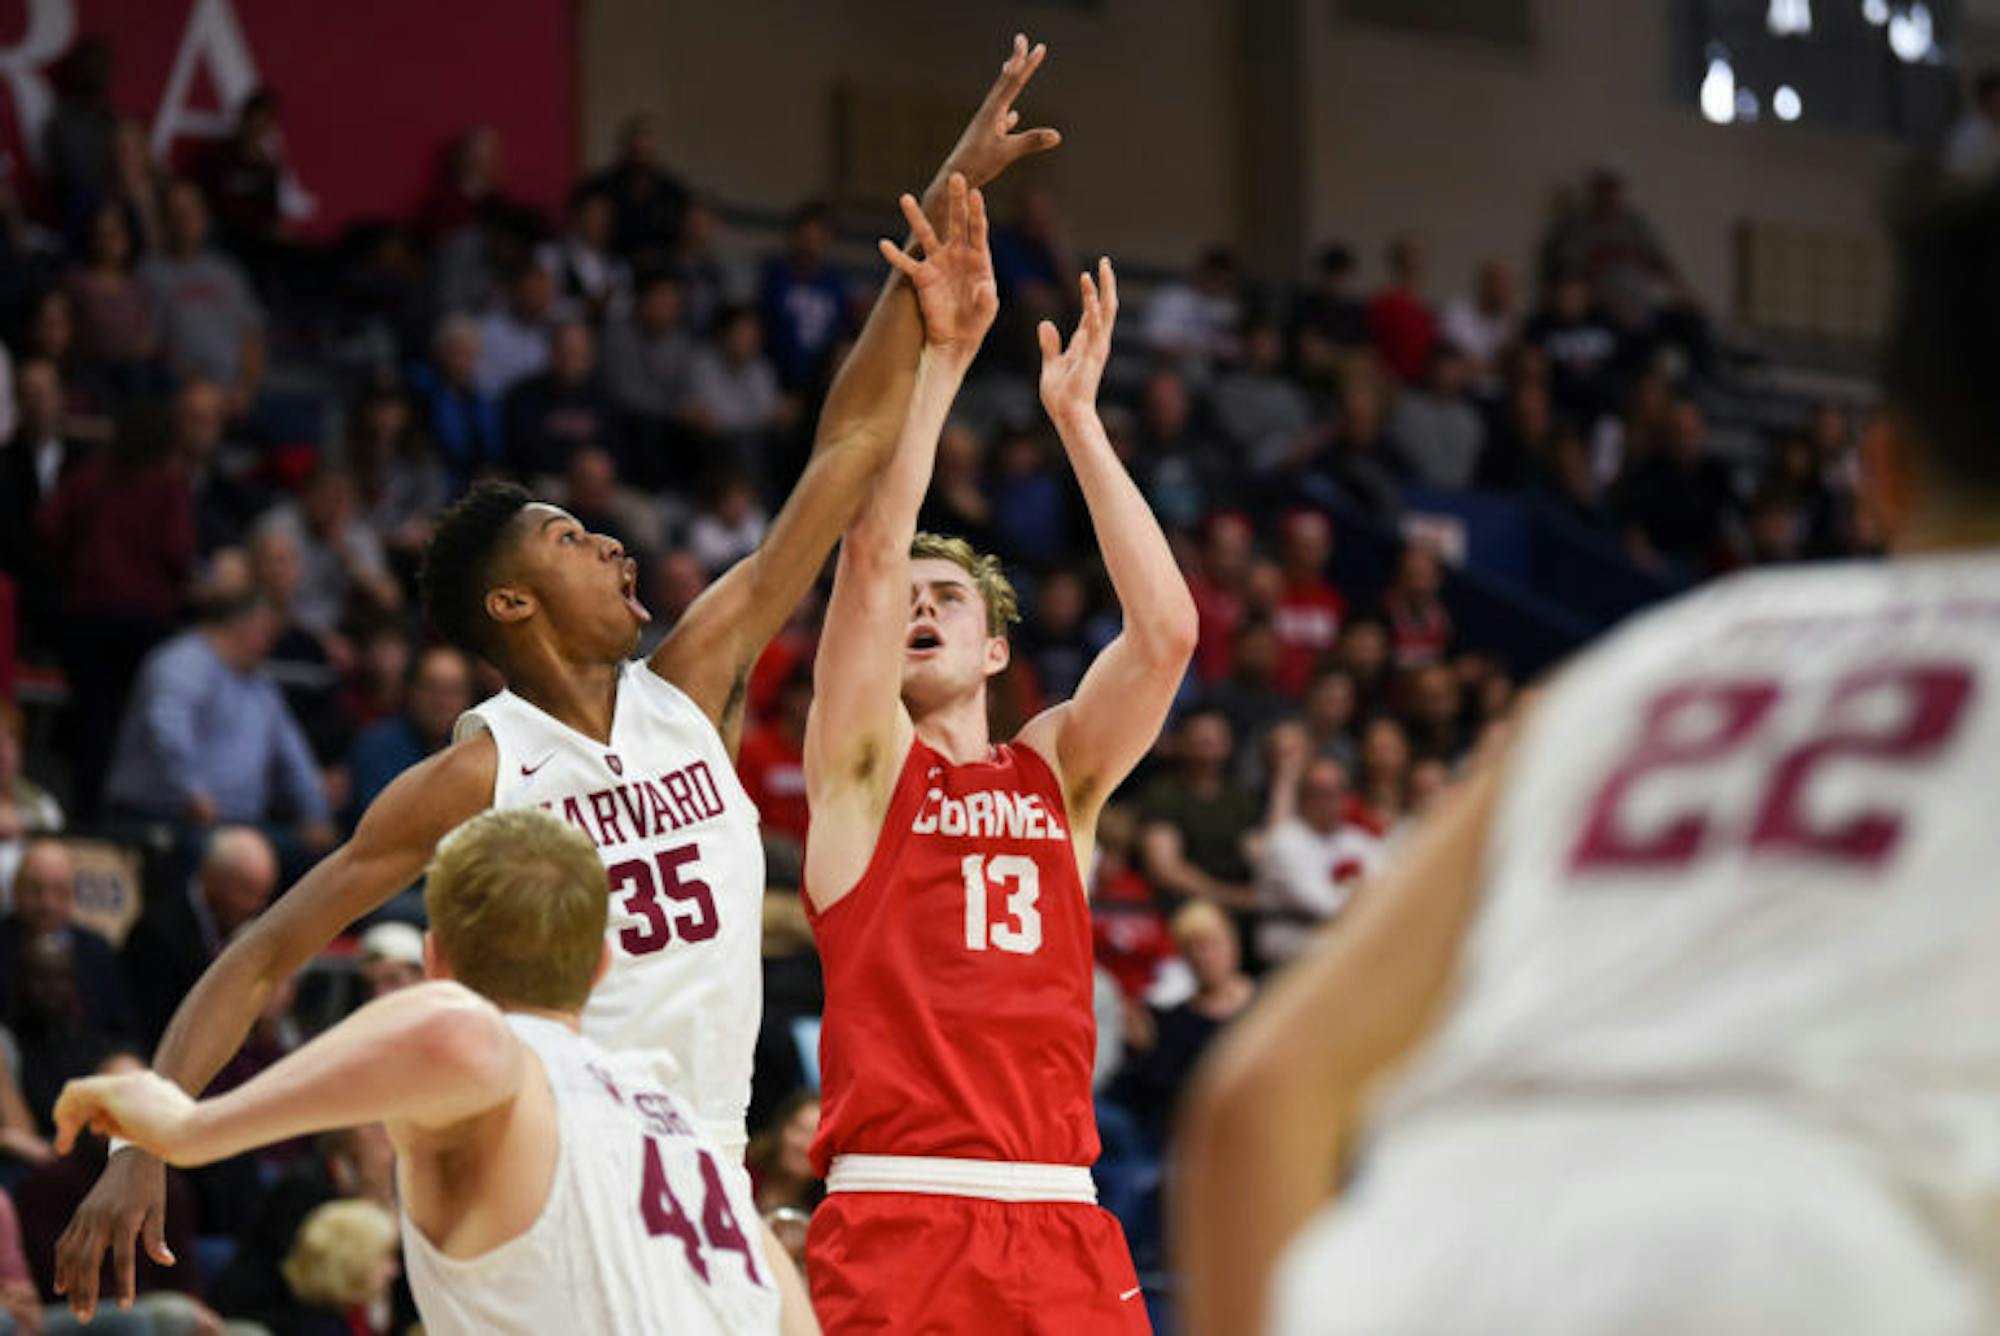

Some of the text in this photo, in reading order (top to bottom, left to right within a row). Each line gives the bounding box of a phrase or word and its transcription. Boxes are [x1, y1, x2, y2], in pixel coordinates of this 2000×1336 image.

[1570, 660, 1977, 874] 22
[607, 843, 720, 956] 35
[961, 854, 1042, 955] 13
[638, 1134, 762, 1287] 44
